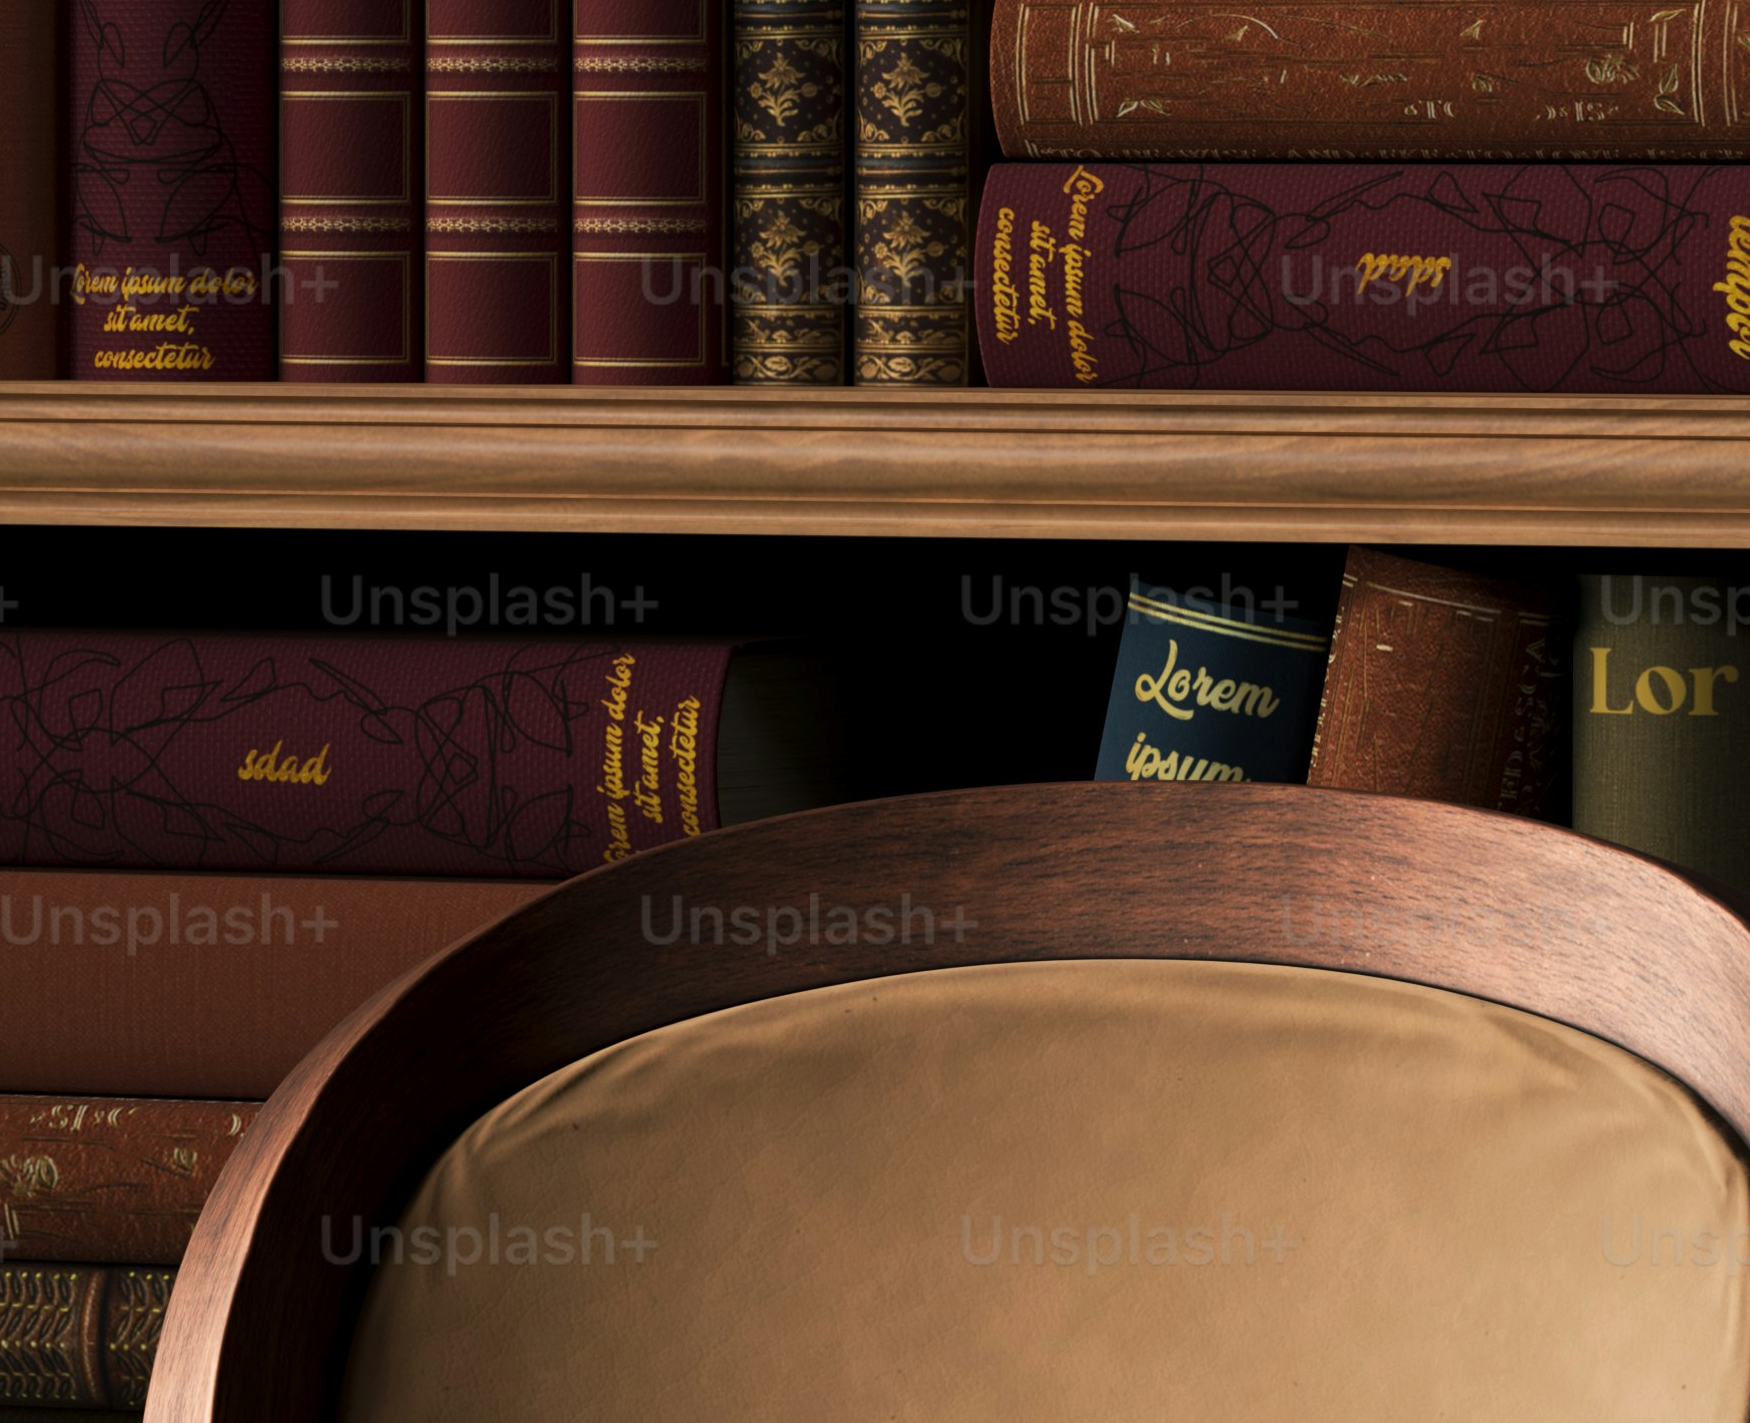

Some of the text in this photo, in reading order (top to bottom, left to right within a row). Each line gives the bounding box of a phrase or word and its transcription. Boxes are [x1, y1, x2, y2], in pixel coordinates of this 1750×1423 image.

[1029, 219, 1057, 263] sit
[70, 262, 259, 306] Lorem ipsum dolor
[992, 206, 1022, 346] consectetur
[1058, 165, 1105, 384] Lorem ipsum dolor
[103, 304, 137, 333] sit
[94, 341, 217, 371] consectetur
[1135, 638, 1282, 721] Lorem
[1589, 646, 1740, 717] Lor
[596, 652, 636, 801] ipsum dolor
[237, 742, 329, 786] sdad
[668, 693, 702, 838] consectetur
[634, 780, 664, 824] sit
